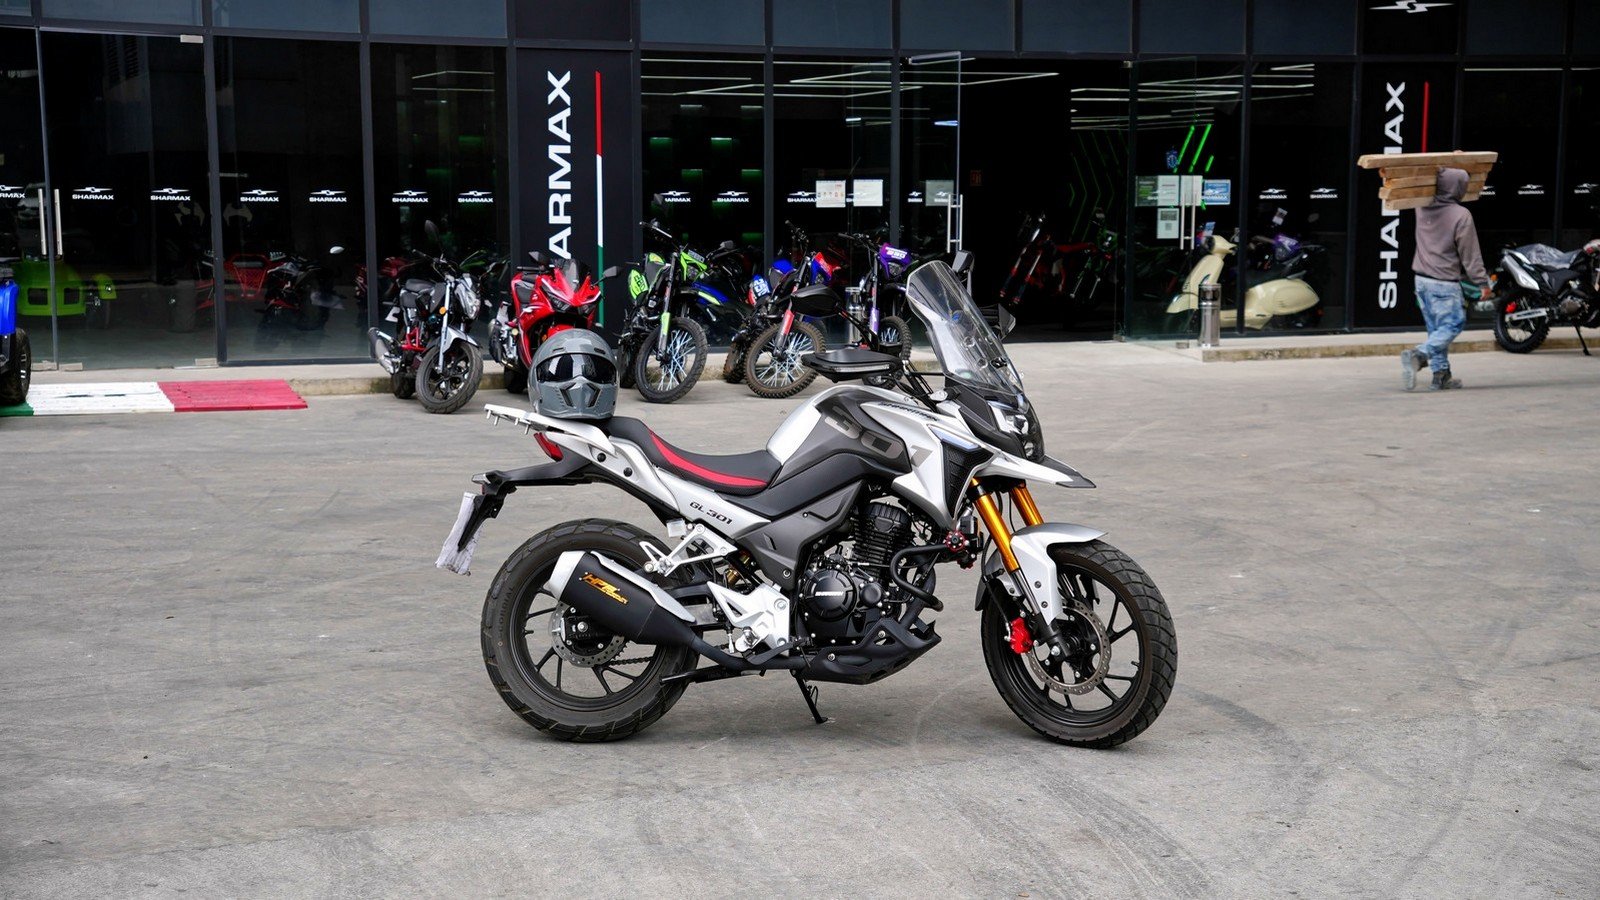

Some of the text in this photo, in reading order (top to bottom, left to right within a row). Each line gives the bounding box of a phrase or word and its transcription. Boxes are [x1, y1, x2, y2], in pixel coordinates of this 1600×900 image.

[547, 70, 572, 260] ARMAX
[1379, 82, 1406, 309] SHAAX
[690, 501, 733, 525] GL 301
